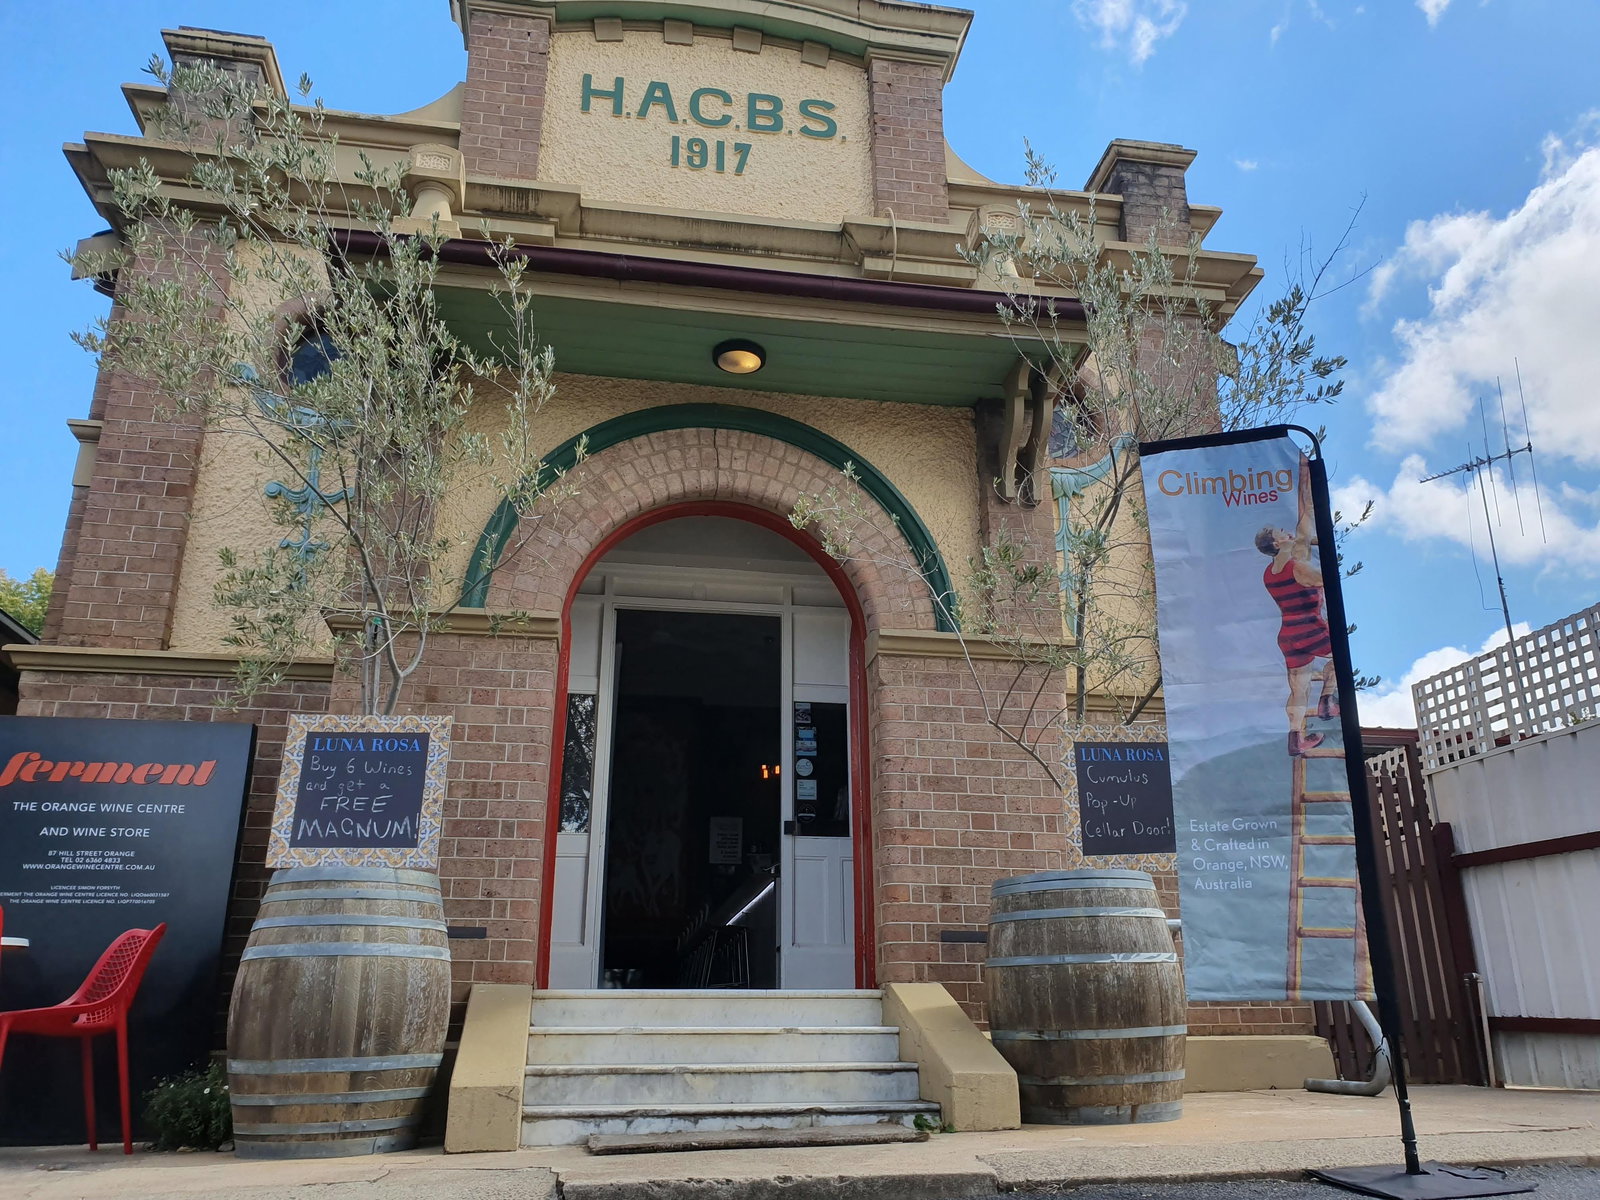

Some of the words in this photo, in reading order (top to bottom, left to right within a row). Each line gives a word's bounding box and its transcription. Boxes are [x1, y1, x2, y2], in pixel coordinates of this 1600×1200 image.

[671, 136, 752, 175] 1917
[1158, 468, 1294, 497] Climbing
[1222, 490, 1279, 508] Wines
[313, 737, 365, 752] LUNA
[372, 738, 421, 752] ROSA
[1080, 747, 1122, 762] LUNA
[1126, 748, 1164, 761] ROSA
[0, 751, 217, 787] ferment
[310, 755, 337, 779] Buy
[347, 758, 356, 774] 6
[364, 760, 413, 776] Wines
[1086, 765, 1149, 784] Cumulus
[305, 780, 328, 791] and
[338, 779, 366, 797] get
[13, 801, 38, 811] THE
[41, 802, 97, 812] ORANGE
[100, 803, 134, 813] WINE
[137, 803, 186, 814] CENTRE
[320, 794, 394, 813] FREE
[39, 827, 69, 837] AND
[73, 827, 106, 837] WINE
[110, 827, 151, 838] STORE
[297, 812, 420, 840] MAGNUM!
[1084, 819, 1125, 838] Cellar
[1132, 816, 1171, 836] Door!
[1190, 819, 1229, 832] Estate
[1232, 817, 1278, 831] Grown
[1191, 838, 1201, 851] &
[1204, 837, 1255, 851] Crafted
[1258, 838, 1270, 849] in
[22, 863, 156, 871] WWW.ORANGEWINECENTRE.COM.AU
[1193, 857, 1247, 872] Orange,
[1250, 855, 1289, 870] NSW,
[1194, 876, 1253, 890] Australia
